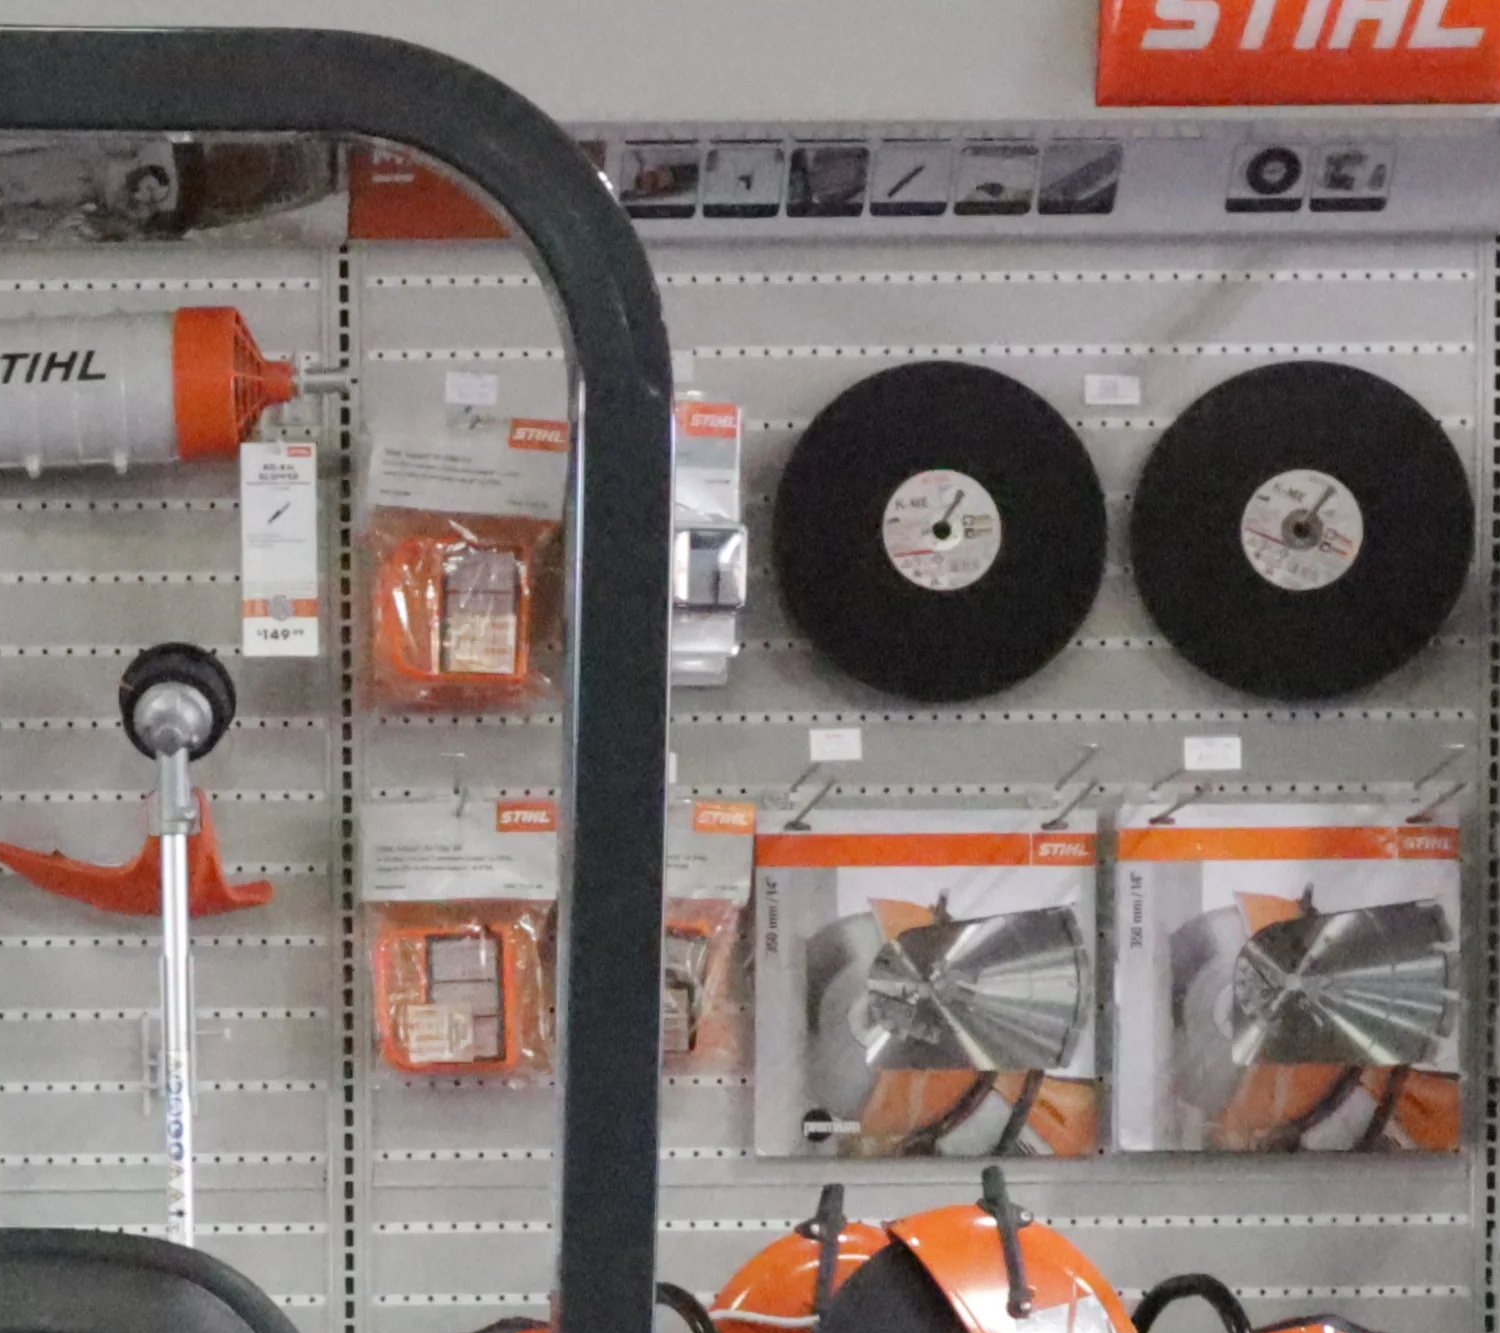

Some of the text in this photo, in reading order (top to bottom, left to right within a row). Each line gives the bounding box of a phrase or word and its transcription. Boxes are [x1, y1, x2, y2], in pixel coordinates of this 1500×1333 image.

[690, 413, 738, 429] STIHL
[513, 427, 566, 444] STIHL
[500, 810, 552, 825] STIHL
[697, 810, 751, 826] STIHL
[1038, 841, 1090, 857] STIHL
